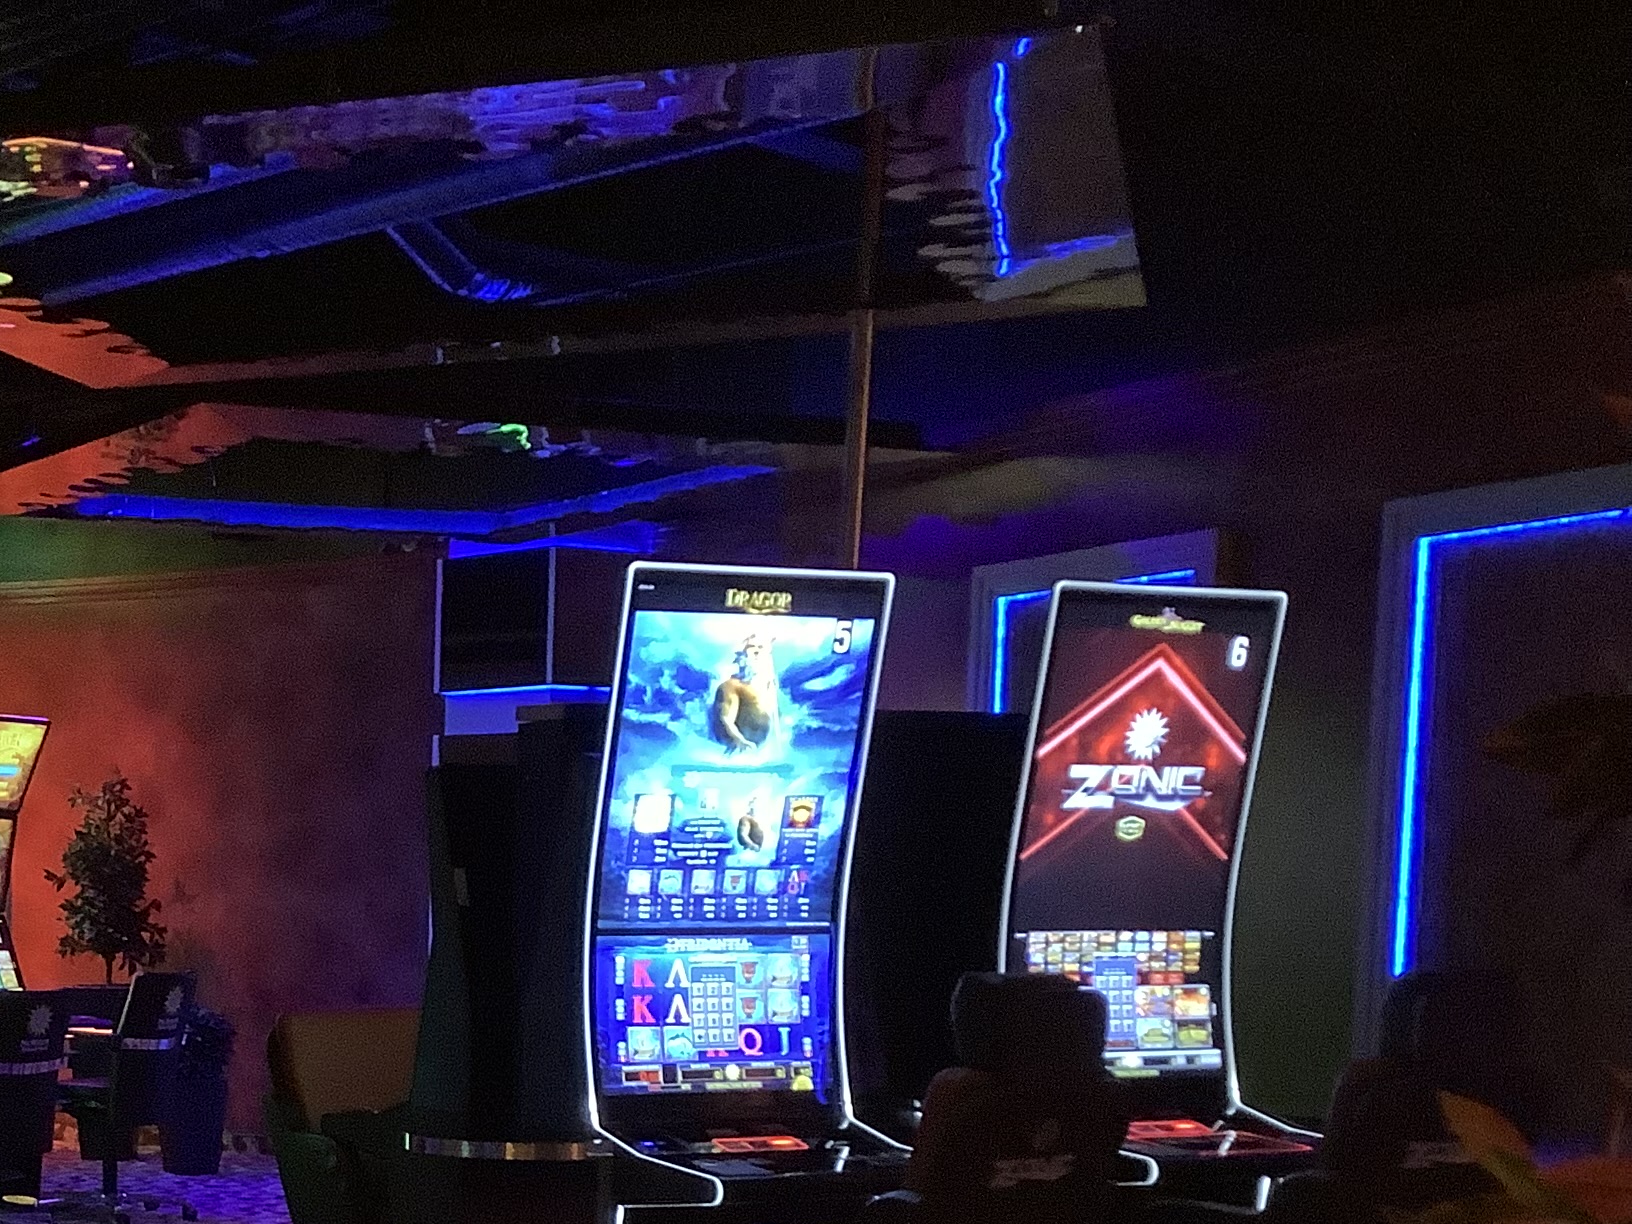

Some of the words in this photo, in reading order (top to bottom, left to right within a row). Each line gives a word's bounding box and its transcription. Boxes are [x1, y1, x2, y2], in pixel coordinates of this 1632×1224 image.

[833, 620, 853, 654] 5
[1229, 635, 1250, 670] 6
[1061, 765, 1206, 810] ZONIC
[632, 959, 656, 988] K
[632, 995, 656, 1023] K
[739, 1027, 764, 1056] Q
[777, 1027, 791, 1056] J
